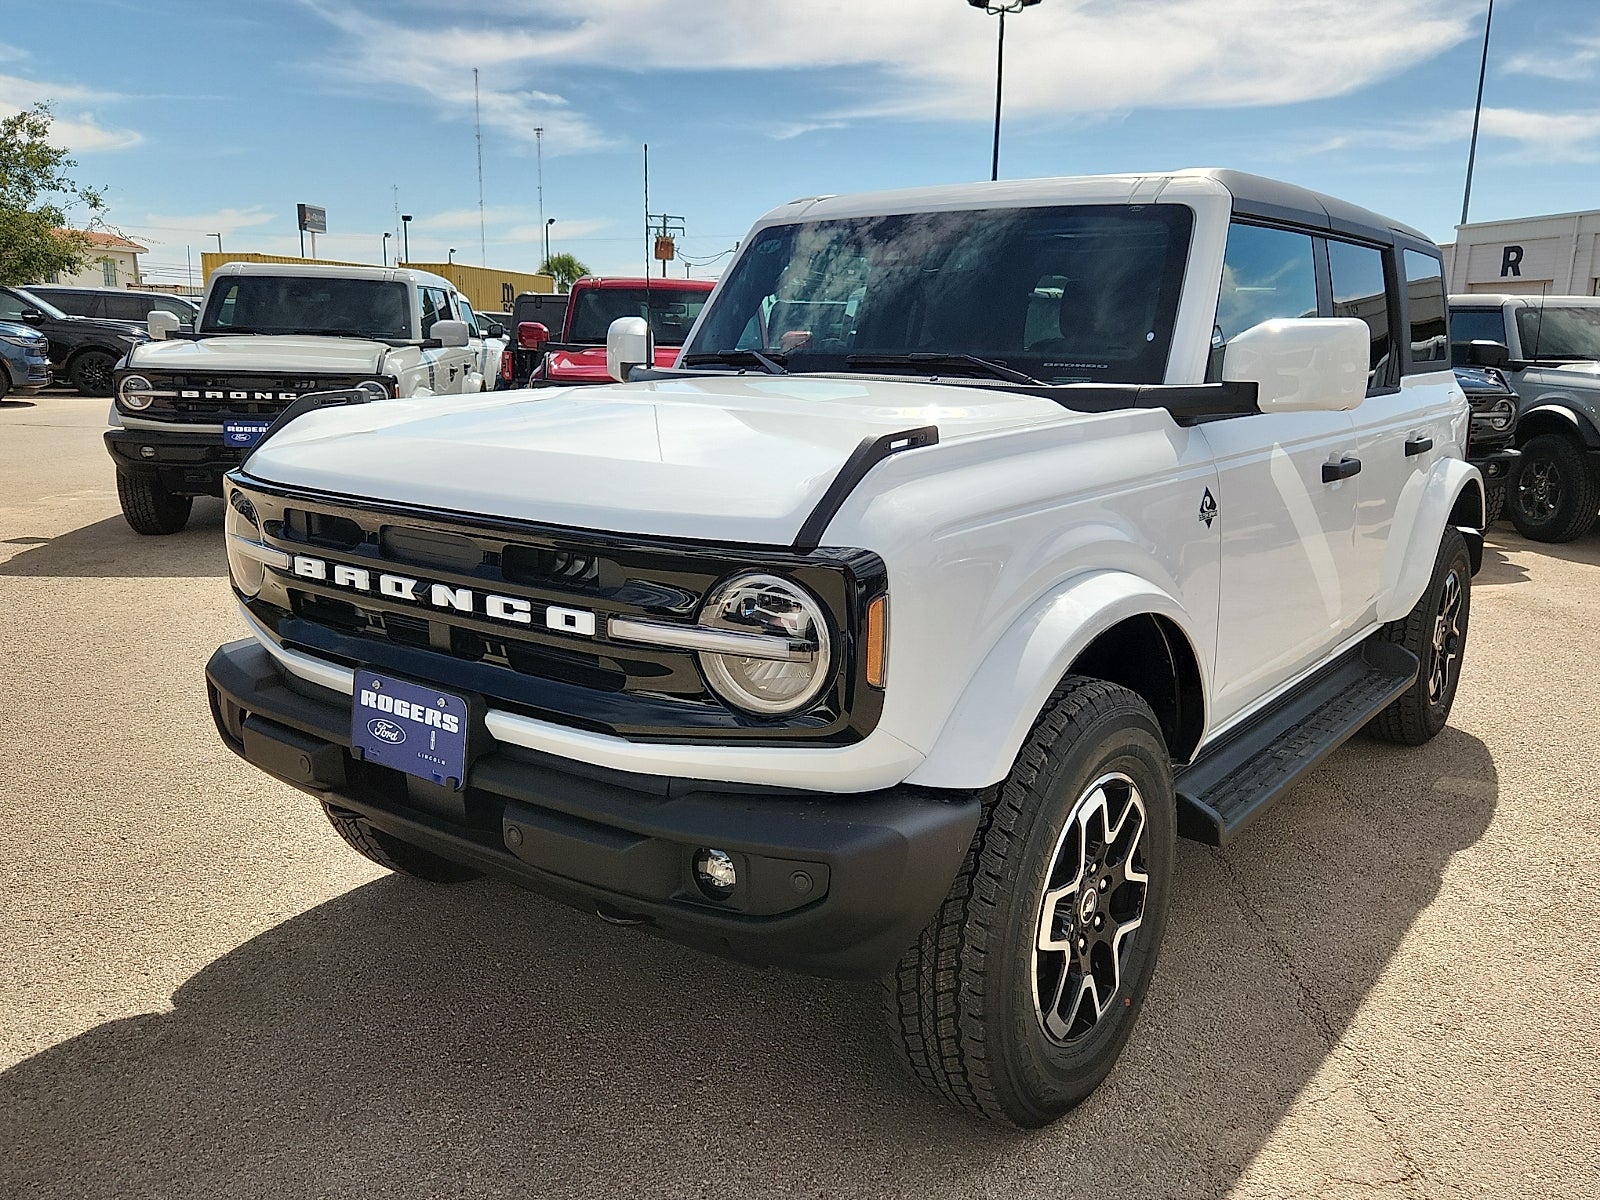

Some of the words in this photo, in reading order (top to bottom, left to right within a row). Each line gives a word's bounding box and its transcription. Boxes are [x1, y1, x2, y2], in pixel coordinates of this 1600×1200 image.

[1500, 245, 1523, 277] R
[181, 390, 297, 400] BRONC
[294, 555, 596, 636] BRONCO
[360, 689, 459, 734] ROGERS
[372, 720, 401, 742] Ford
[417, 752, 446, 766] LINCOLN
